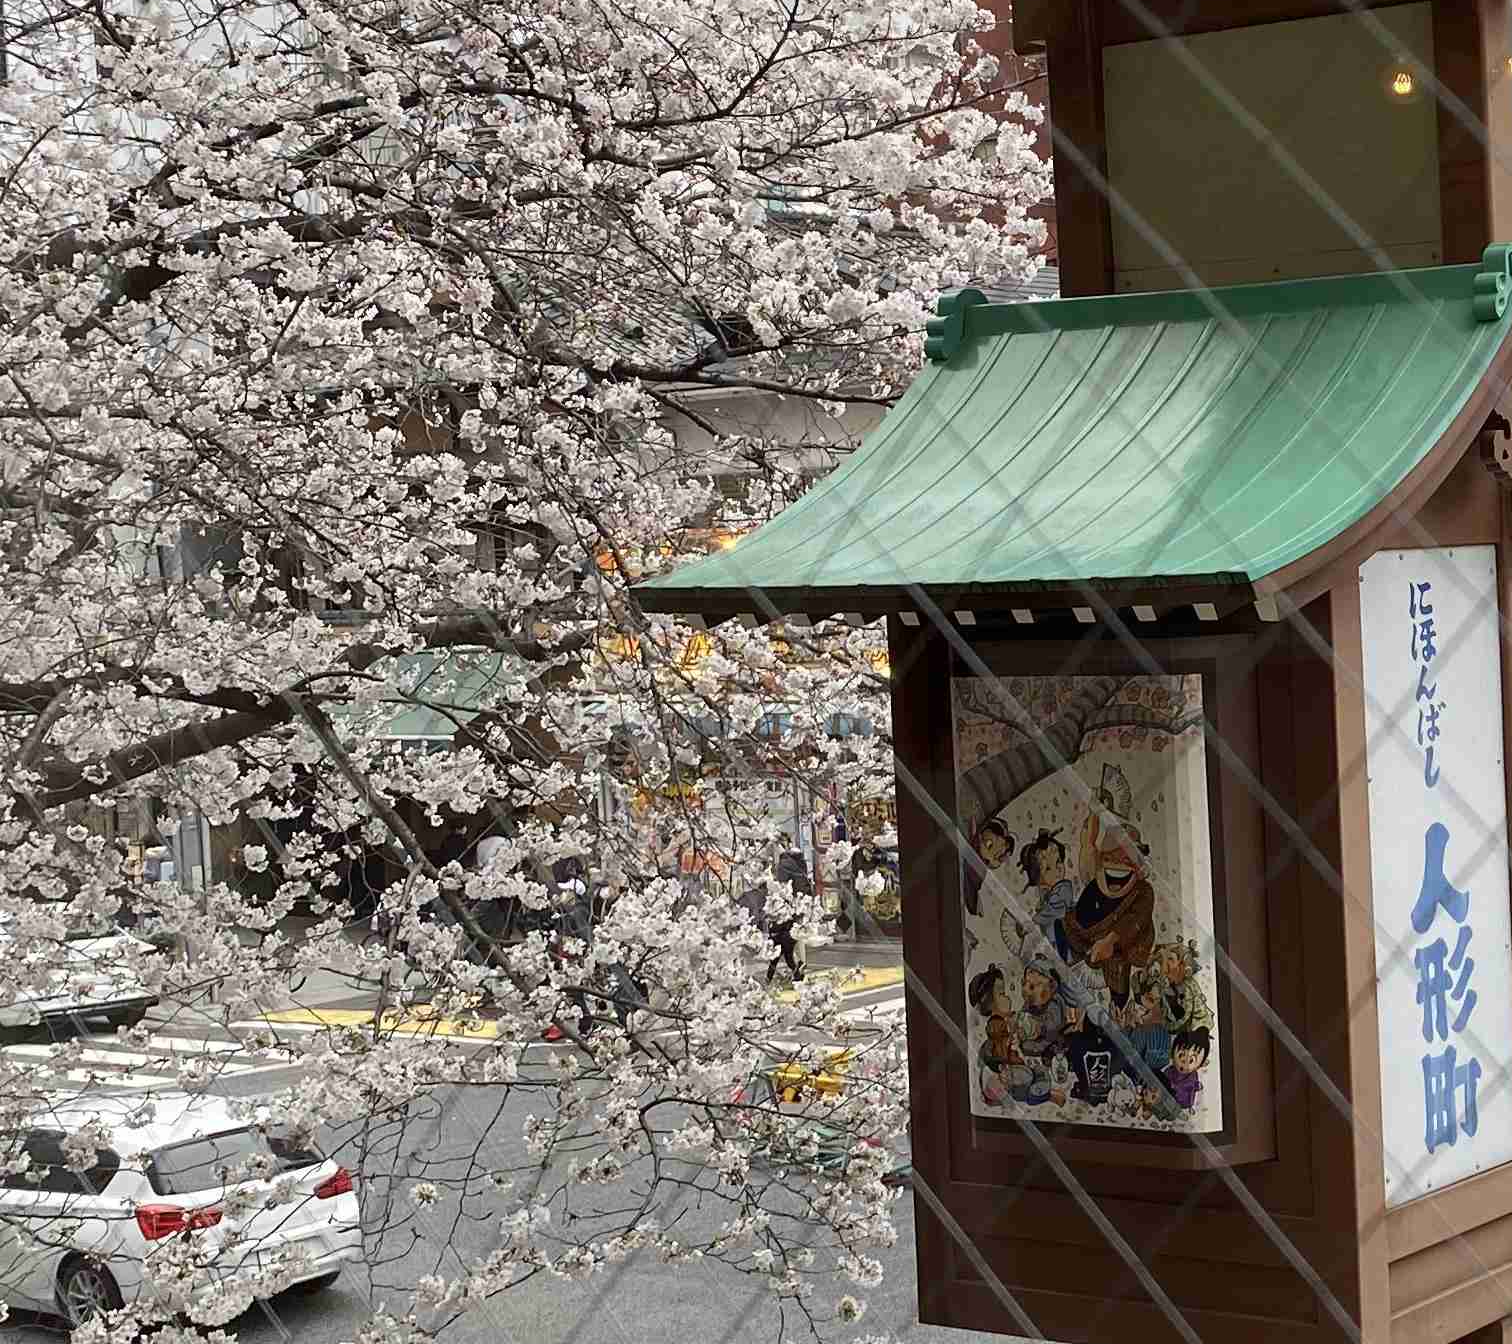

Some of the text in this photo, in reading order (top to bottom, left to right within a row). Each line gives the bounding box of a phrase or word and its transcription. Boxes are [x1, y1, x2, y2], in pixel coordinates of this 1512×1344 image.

[1408, 581, 1482, 1156] にほんばし 人形町
